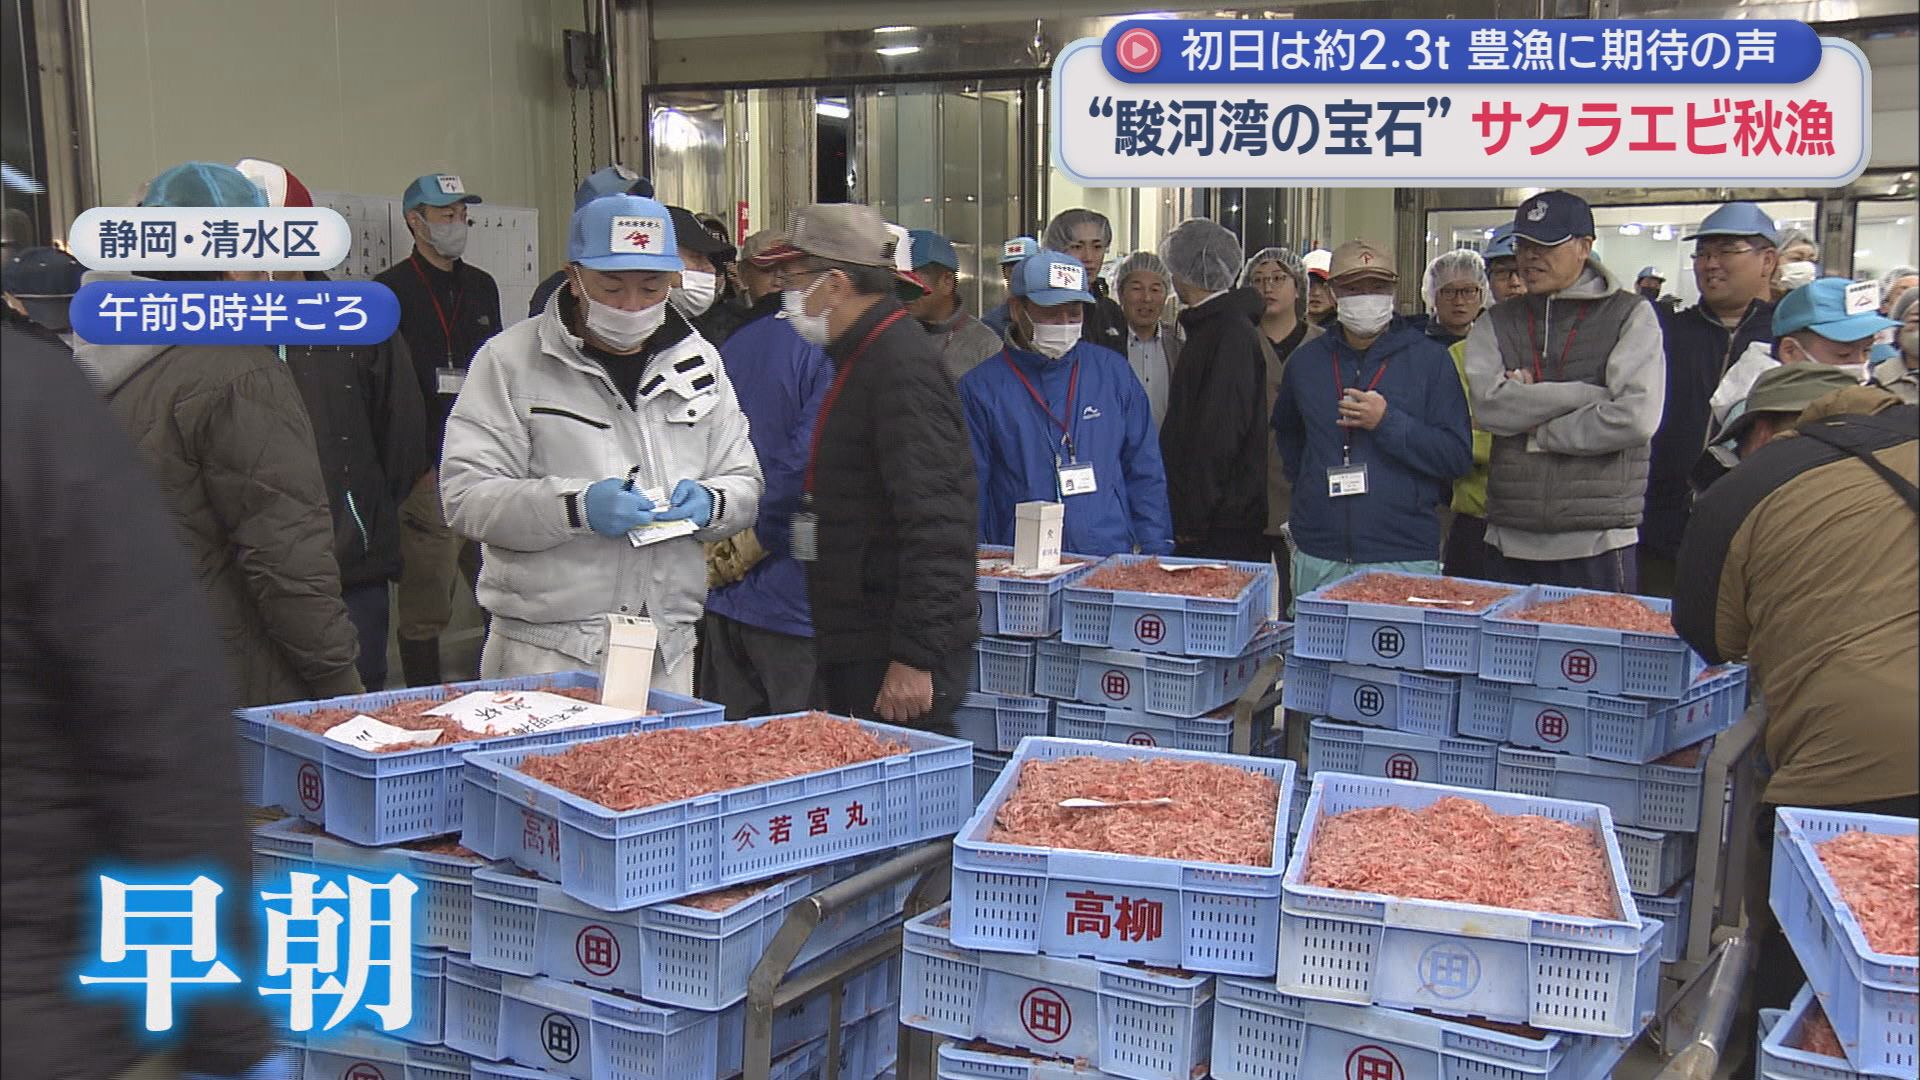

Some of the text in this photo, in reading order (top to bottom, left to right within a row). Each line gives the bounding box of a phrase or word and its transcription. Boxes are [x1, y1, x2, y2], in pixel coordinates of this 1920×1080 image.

[768, 800, 869, 845] 若宮丸
[1065, 890, 1163, 943] 高柳
